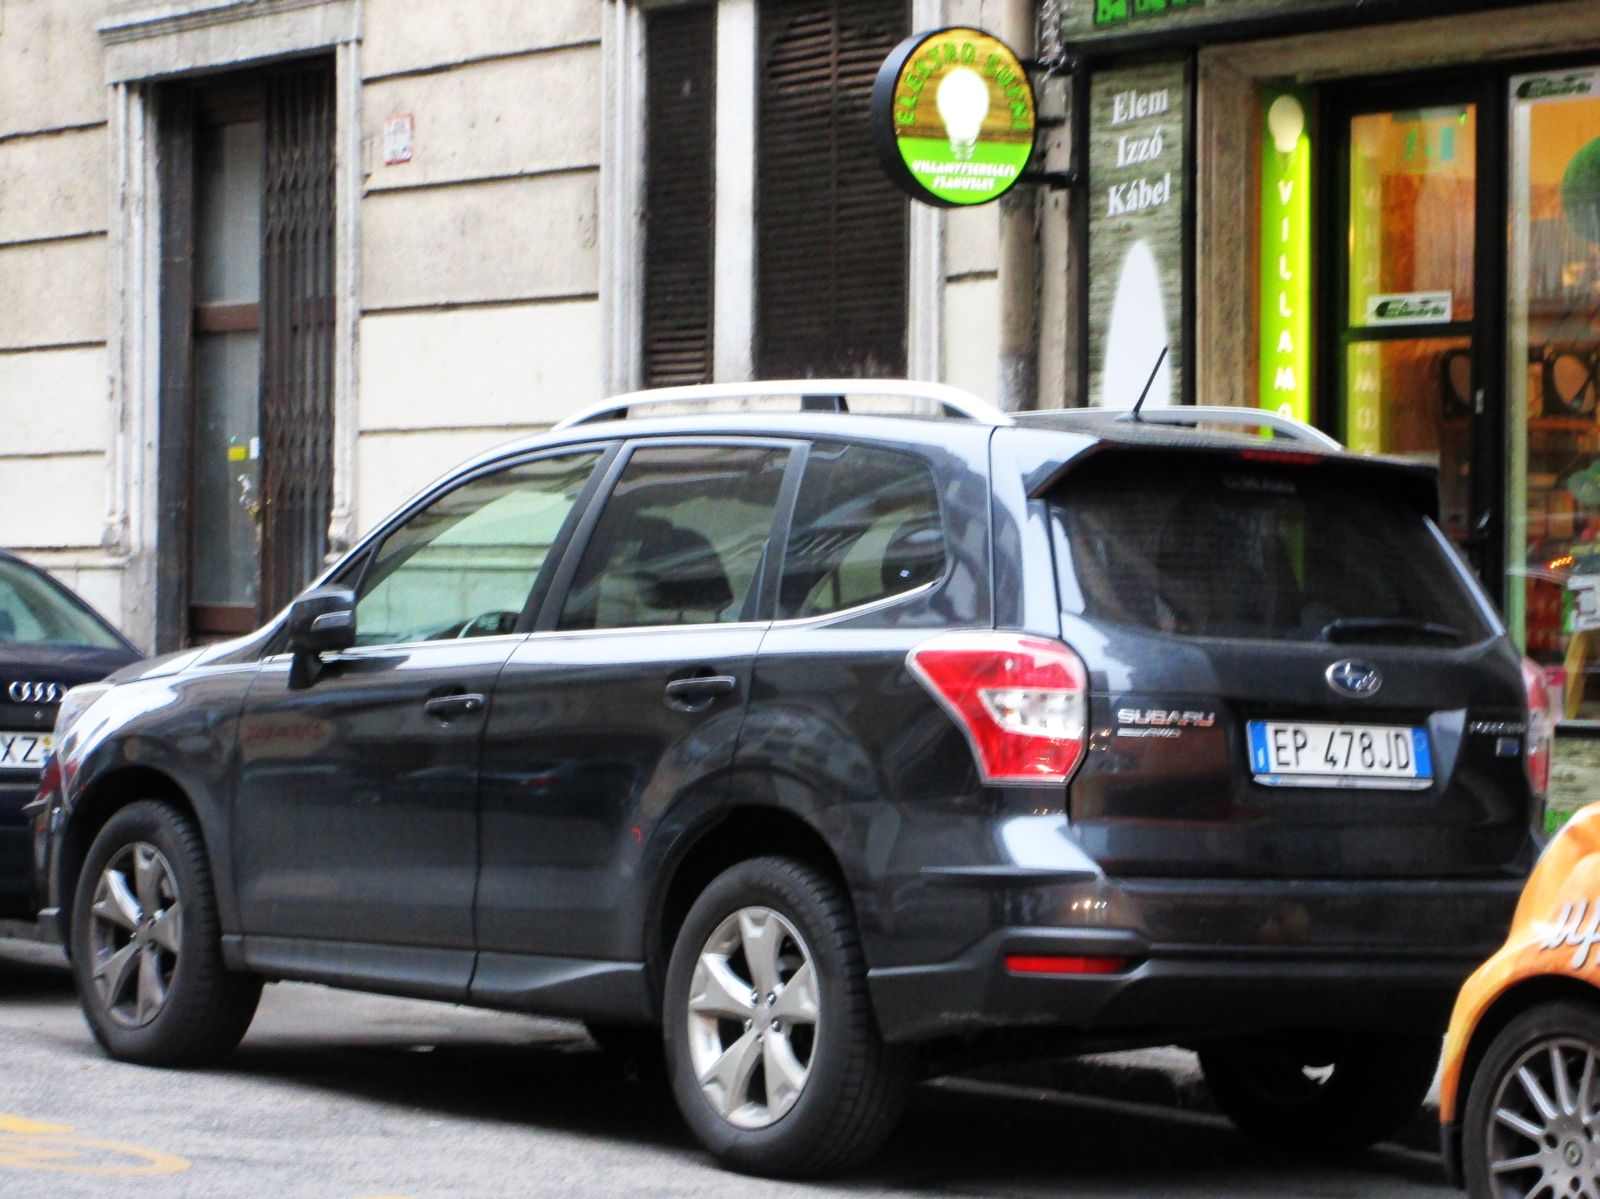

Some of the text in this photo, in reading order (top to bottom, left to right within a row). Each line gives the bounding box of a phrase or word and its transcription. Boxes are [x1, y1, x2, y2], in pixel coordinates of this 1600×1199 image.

[1111, 88, 1169, 125] Elem
[1115, 126, 1164, 169] Izzó
[1106, 172, 1172, 217] Kábel
[1117, 708, 1216, 727] SUBARU
[1273, 728, 1411, 771] EP 478JD
